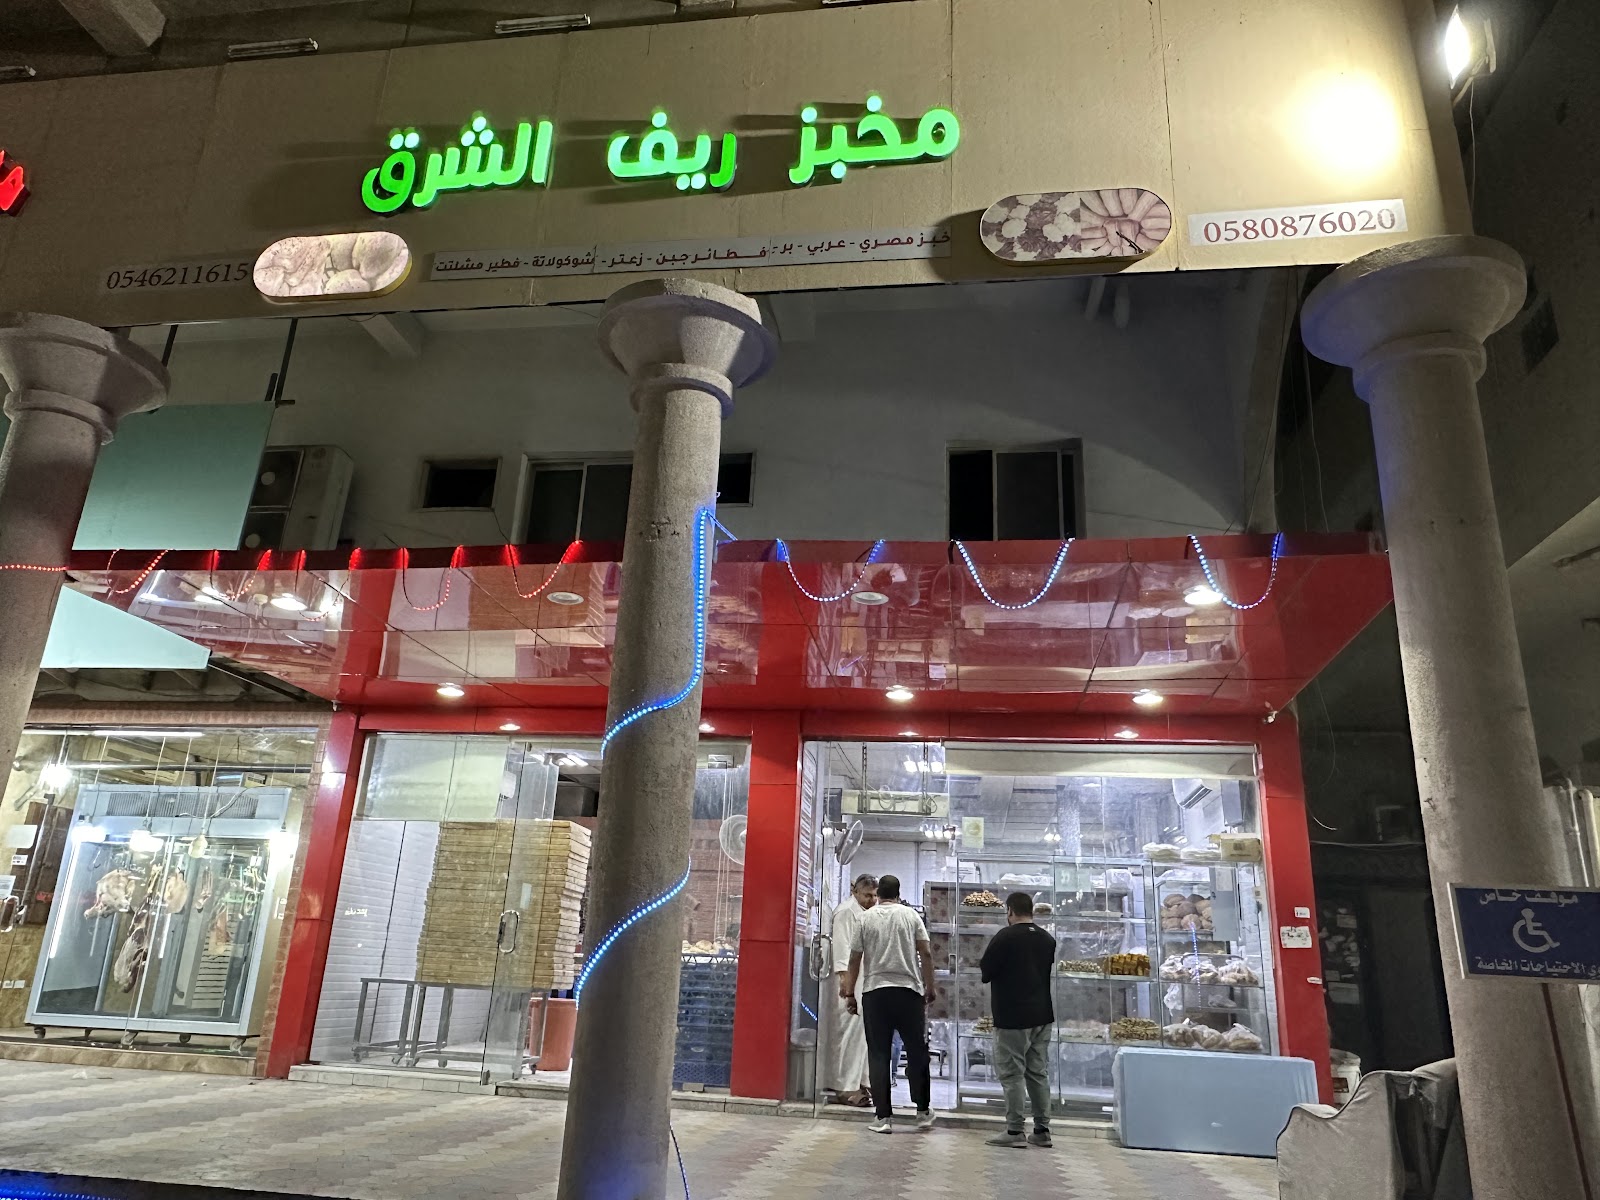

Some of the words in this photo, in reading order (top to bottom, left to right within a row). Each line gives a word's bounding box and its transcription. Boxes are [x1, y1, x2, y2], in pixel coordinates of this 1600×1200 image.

[789, 95, 960, 185] مخبز
[607, 111, 737, 190] ريف
[361, 116, 553, 214] الشرق
[1203, 207, 1396, 243] 0580876020
[859, 236, 914, 252] مصري
[916, 231, 951, 247] خبز
[691, 246, 766, 264] فطائر
[779, 242, 794, 254] بر
[807, 240, 846, 255] عربي
[435, 257, 484, 271] مشلتت
[485, 257, 521, 272] فطير
[532, 251, 595, 268] شوكولاتة
[608, 252, 644, 267] زعتر
[655, 252, 690, 266] جبن
[106, 261, 249, 290] 0546211615
[1475, 956, 1518, 971] الخاصة
